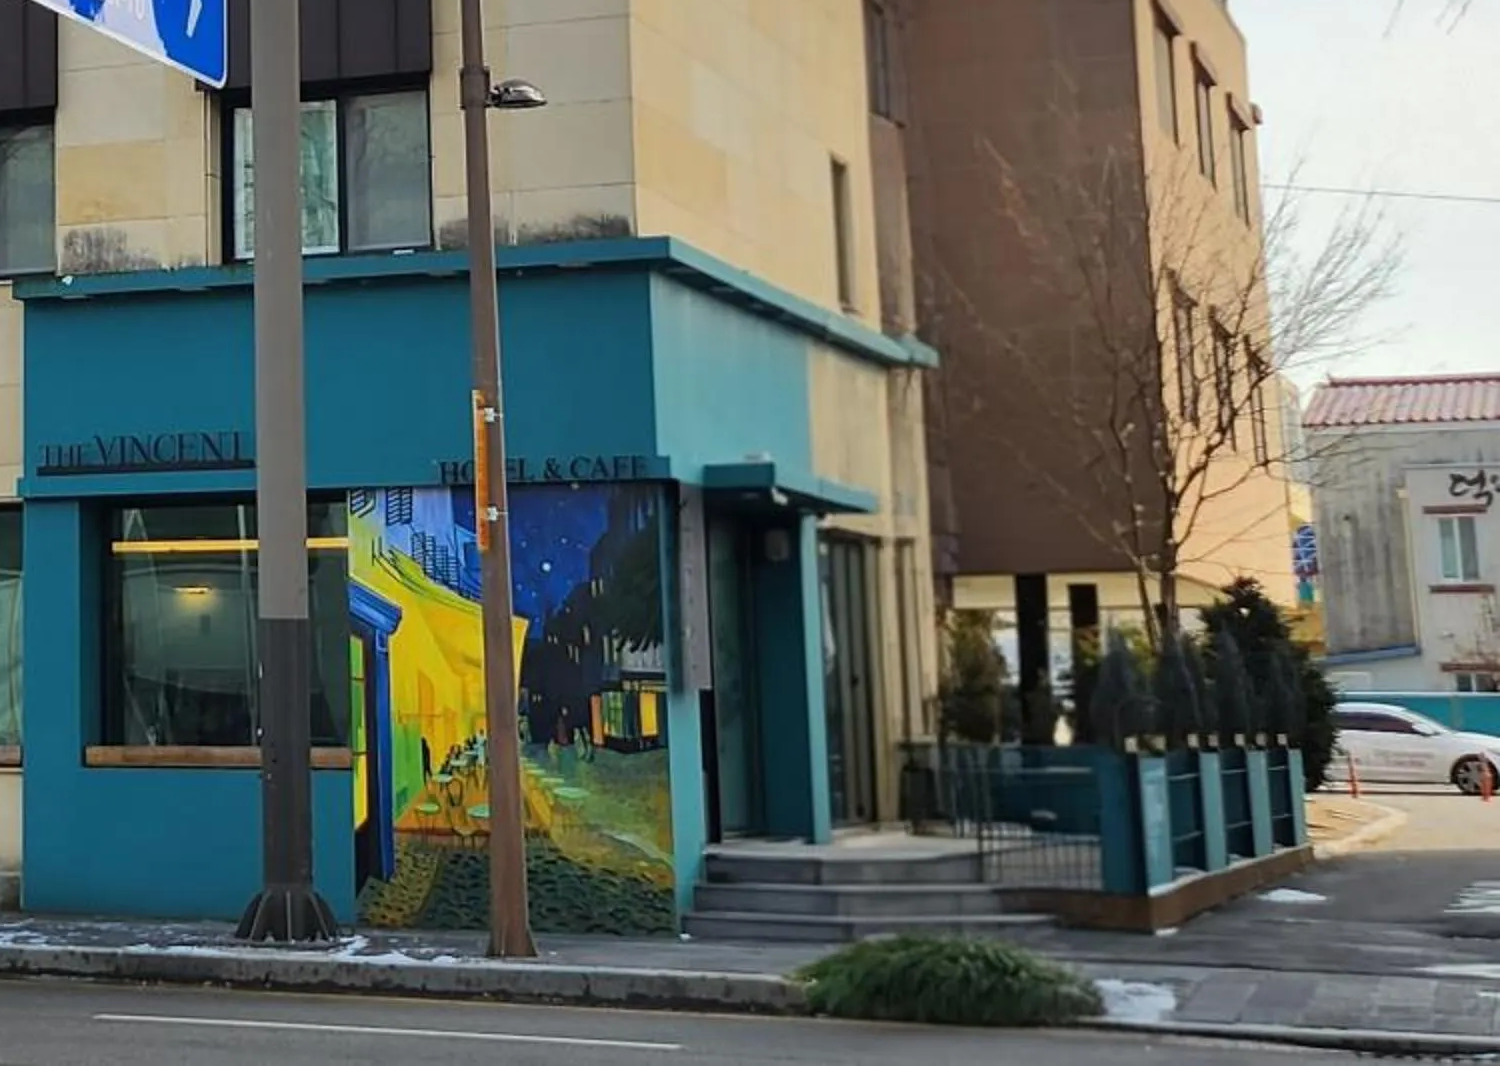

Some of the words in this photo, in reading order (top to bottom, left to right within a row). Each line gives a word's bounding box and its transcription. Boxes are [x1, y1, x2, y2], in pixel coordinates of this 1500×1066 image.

[40, 444, 91, 467] THE
[94, 431, 256, 466] VINCENT
[439, 457, 534, 484] HOEL
[543, 458, 562, 480] &
[569, 455, 648, 480] CAFE
